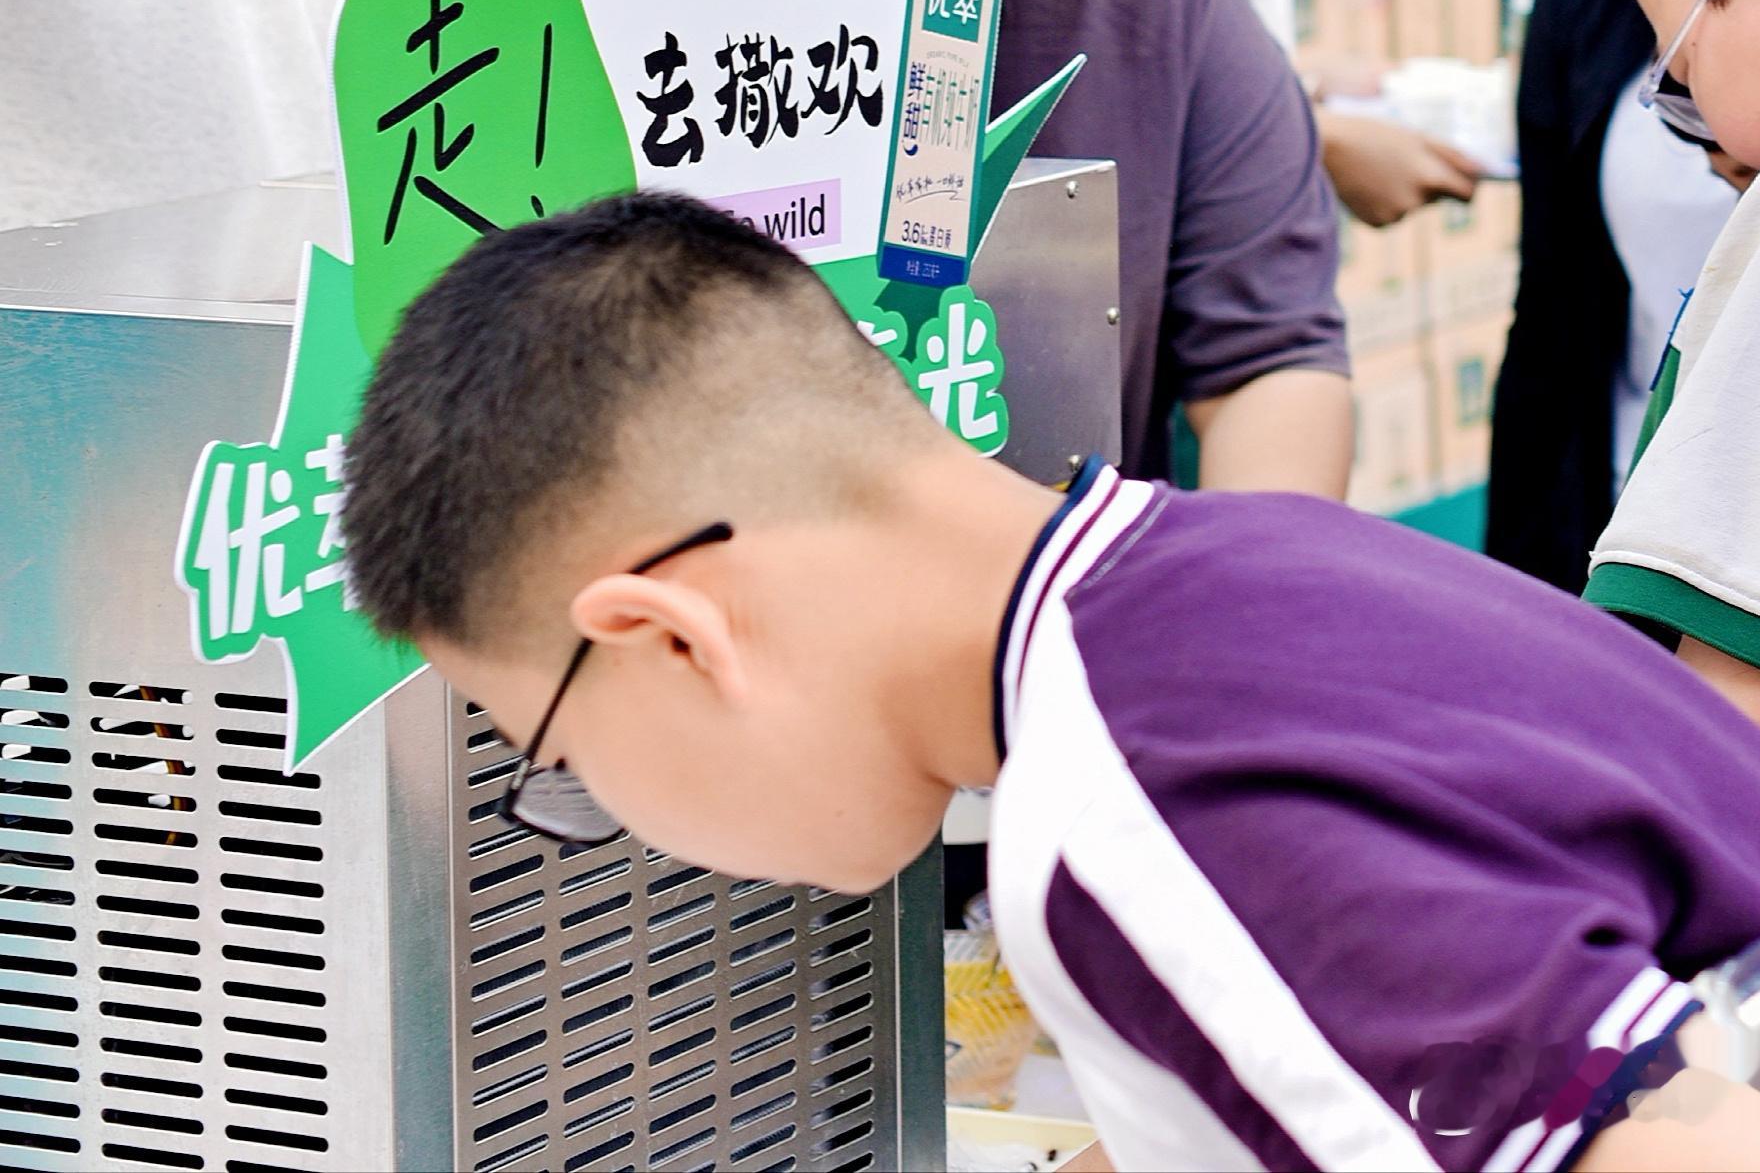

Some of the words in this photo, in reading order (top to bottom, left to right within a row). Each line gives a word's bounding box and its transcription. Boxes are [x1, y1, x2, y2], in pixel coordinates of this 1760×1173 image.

[636, 23, 884, 168] 去撒欢
[764, 193, 826, 241] wild
[901, 219, 921, 244] 3.6
